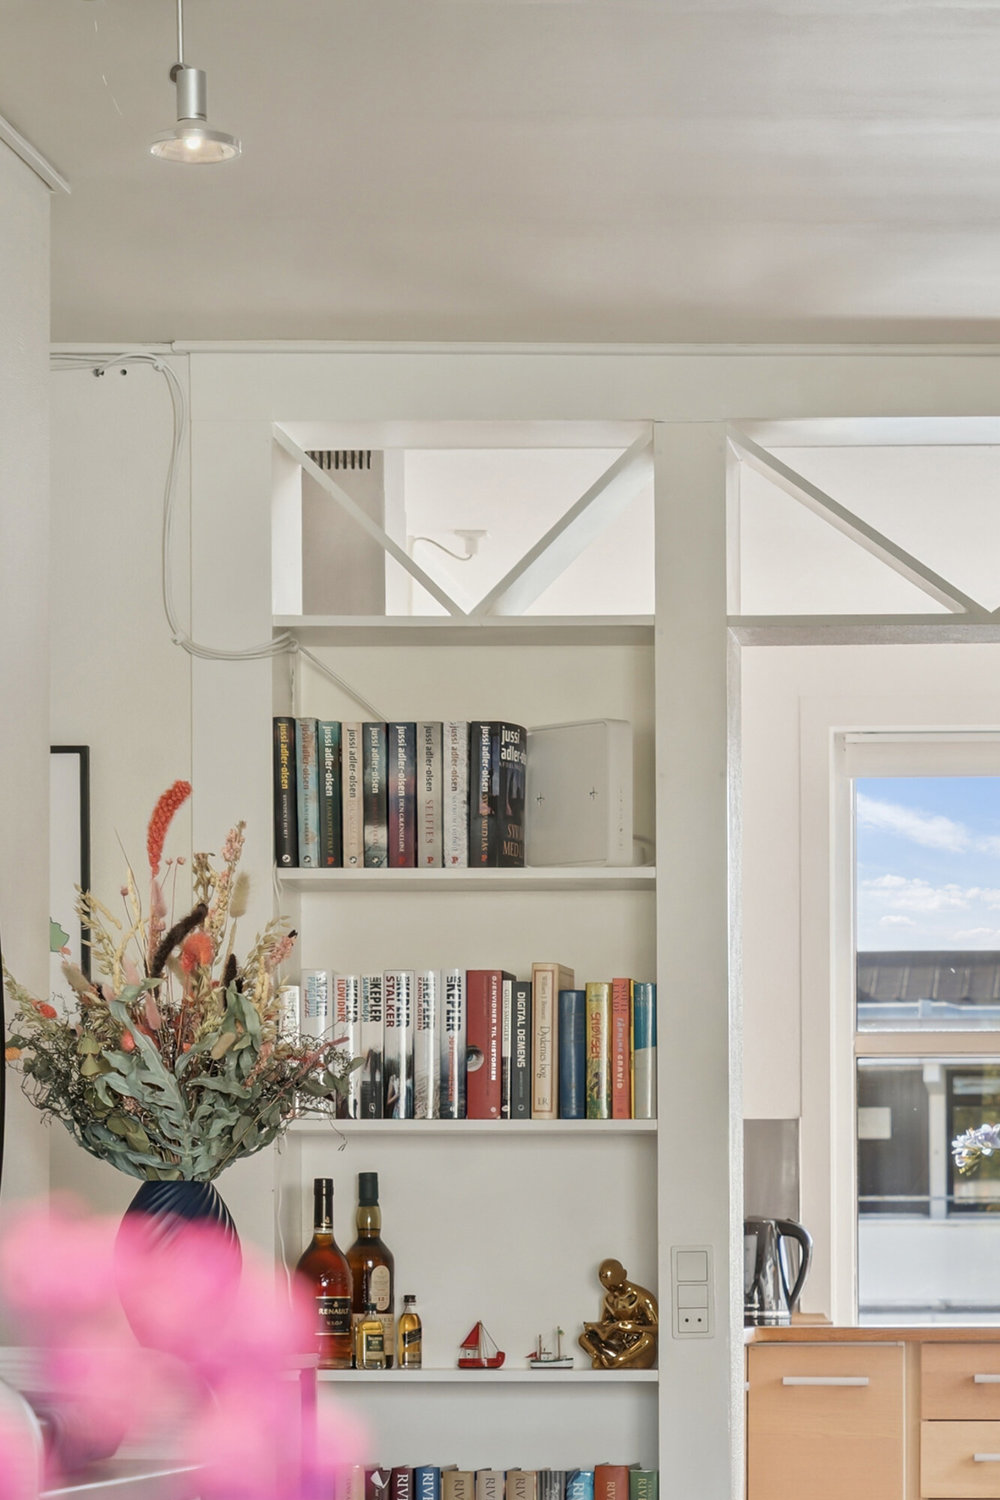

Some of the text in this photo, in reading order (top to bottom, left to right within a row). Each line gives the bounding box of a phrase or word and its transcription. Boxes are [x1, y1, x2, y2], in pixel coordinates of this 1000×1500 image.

[278, 723, 289, 790] jussi adler-olsen
[300, 723, 312, 790] jussi adler-olsen
[346, 729, 359, 748] jussi
[369, 727, 381, 746] jussi
[424, 726, 436, 792] jussi adler-olsen
[449, 726, 461, 792] jussi adler-olsen
[479, 726, 491, 792] jussi adler-olsen
[501, 726, 520, 745] jussi
[322, 726, 336, 797] jussi adler-olsen
[349, 750, 359, 798] adler-olsen
[371, 748, 380, 794] adler-olsen
[396, 726, 407, 796] jussi adler-olsen
[370, 983, 382, 1022] KEPLER
[386, 976, 396, 1028] STALKER
[446, 983, 462, 1032] KEPLER
[517, 991, 526, 1027] DIGITAL
[517, 1029, 526, 1068] DEMENS
[536, 1063, 551, 1078] bog
[616, 1054, 625, 1089] GRAVID
[318, 1306, 350, 1315] RENAULT
